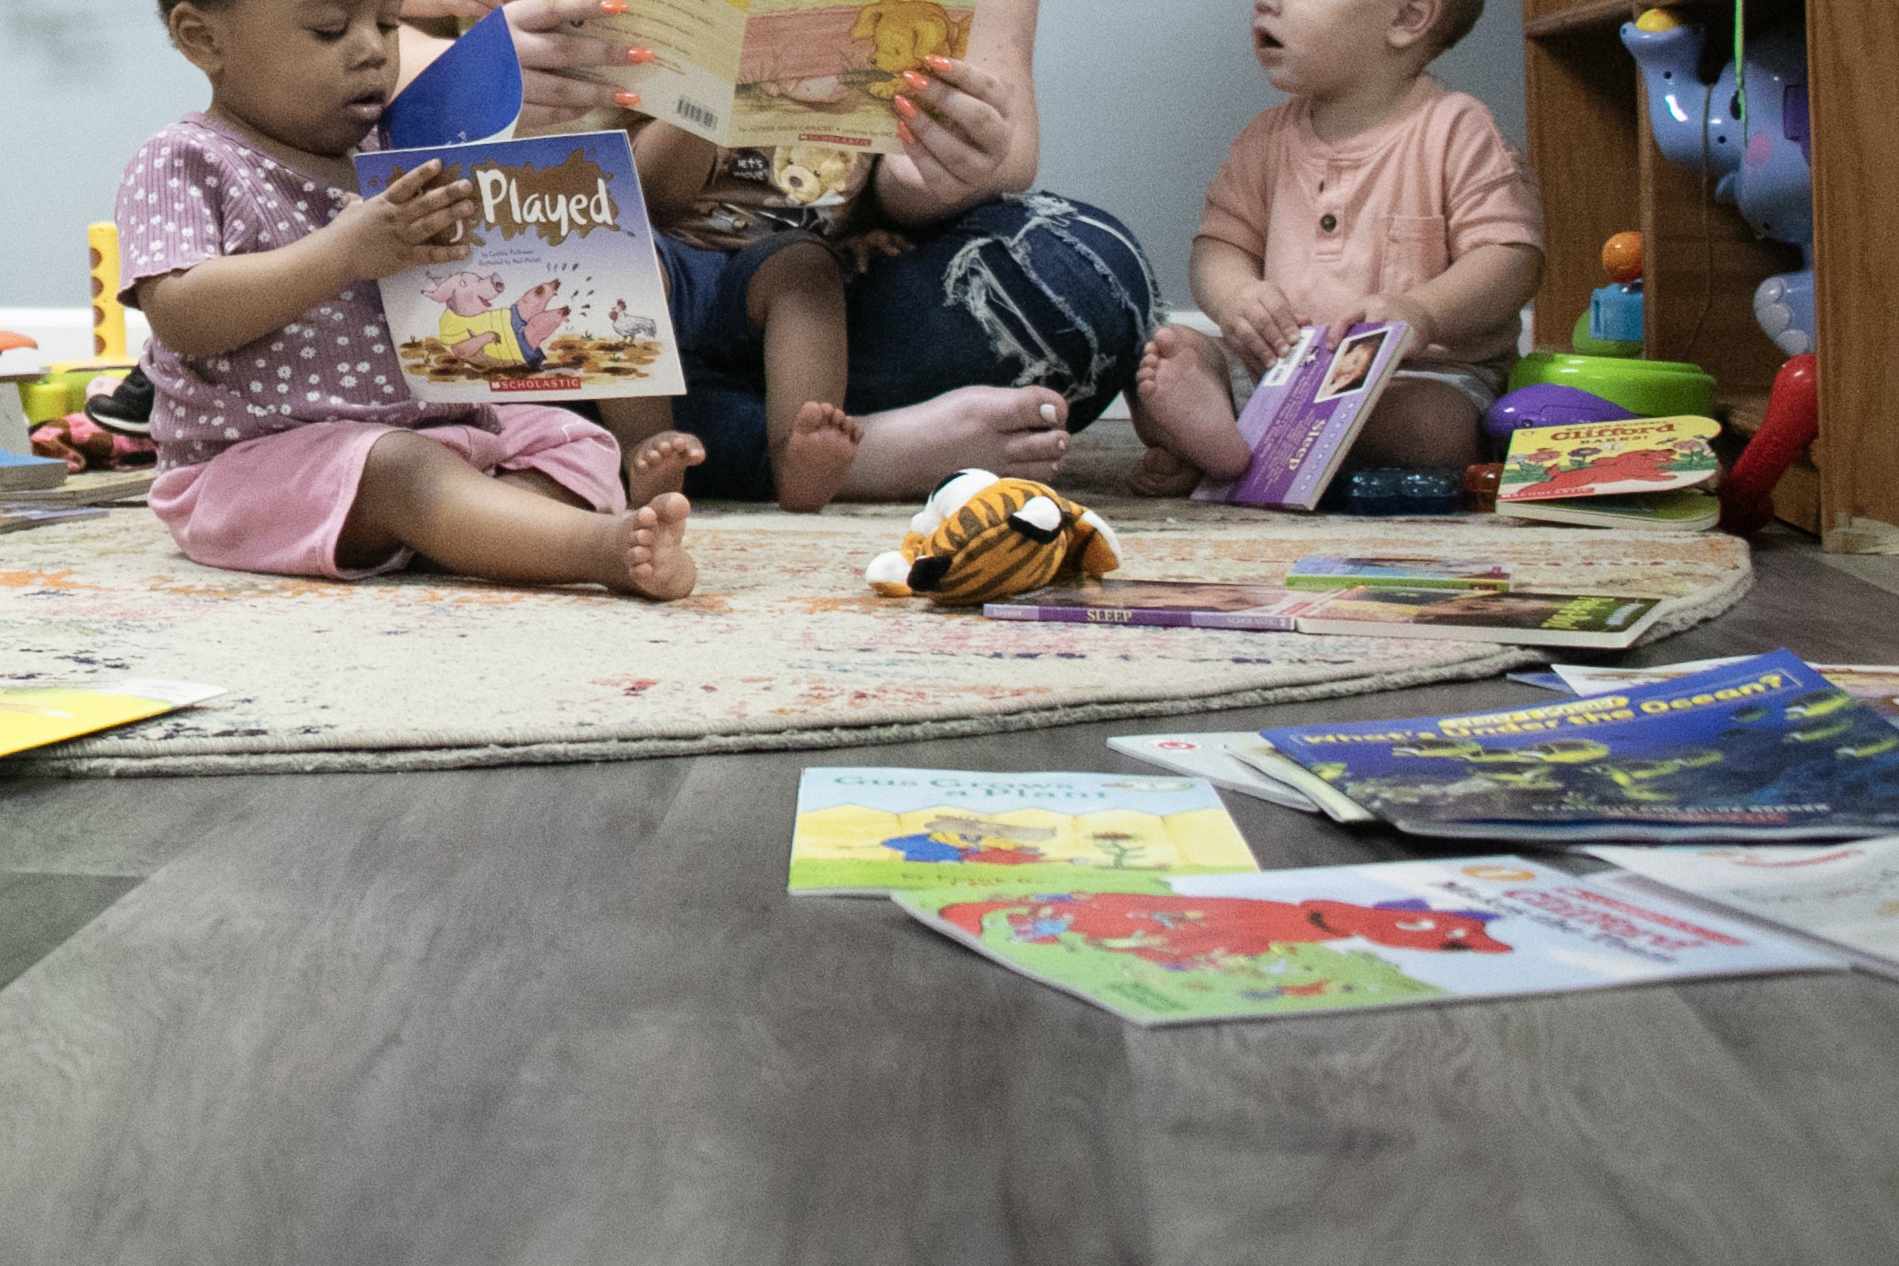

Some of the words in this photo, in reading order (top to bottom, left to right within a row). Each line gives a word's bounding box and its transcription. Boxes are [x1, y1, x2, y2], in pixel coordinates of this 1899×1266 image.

[476, 169, 613, 236] Played
[501, 378, 579, 389] SCHOLASTIC
[1550, 423, 1676, 441] Clifford
[1288, 419, 1327, 471] Sleep
[1086, 608, 1133, 623] SLEEP
[1441, 719, 1561, 737] Under
[1566, 707, 1635, 726] the
[1640, 673, 1784, 714] Ocean?
[834, 776, 918, 786] Gus
[930, 777, 1075, 790] Grows
[984, 788, 1107, 799] Plant
